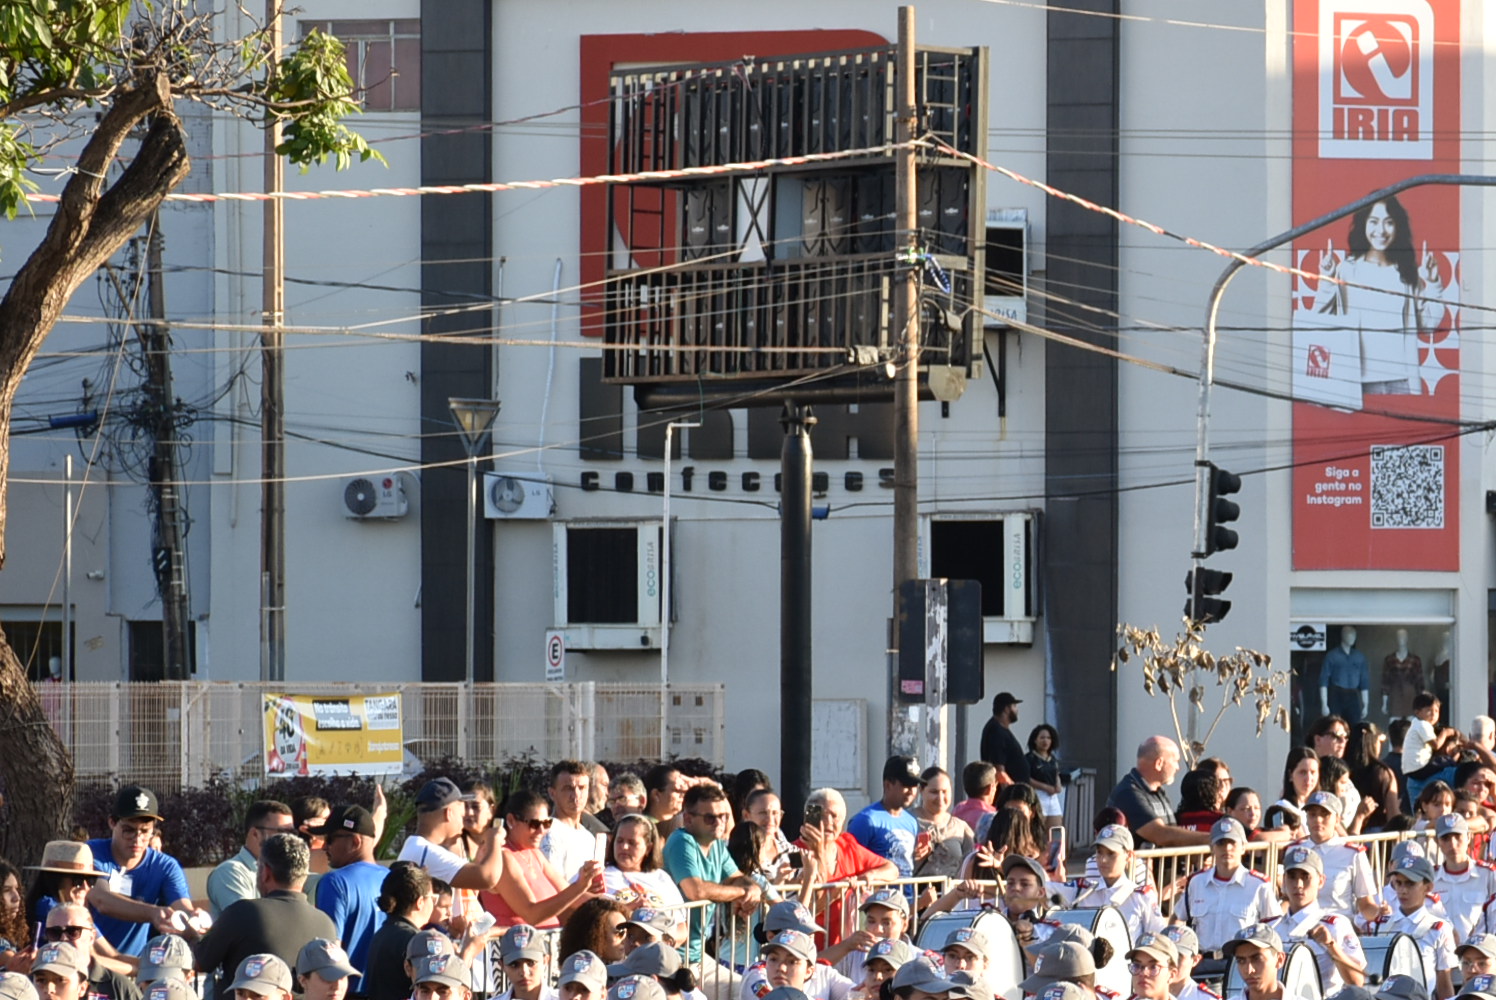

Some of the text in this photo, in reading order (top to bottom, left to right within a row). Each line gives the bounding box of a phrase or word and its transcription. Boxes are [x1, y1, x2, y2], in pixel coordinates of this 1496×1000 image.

[1332, 107, 1420, 142] IRIA
[1325, 466, 1359, 479] Siga a
[1315, 481, 1362, 493] gente no
[1307, 494, 1362, 507] Instagram
[552, 643, 560, 660] E
